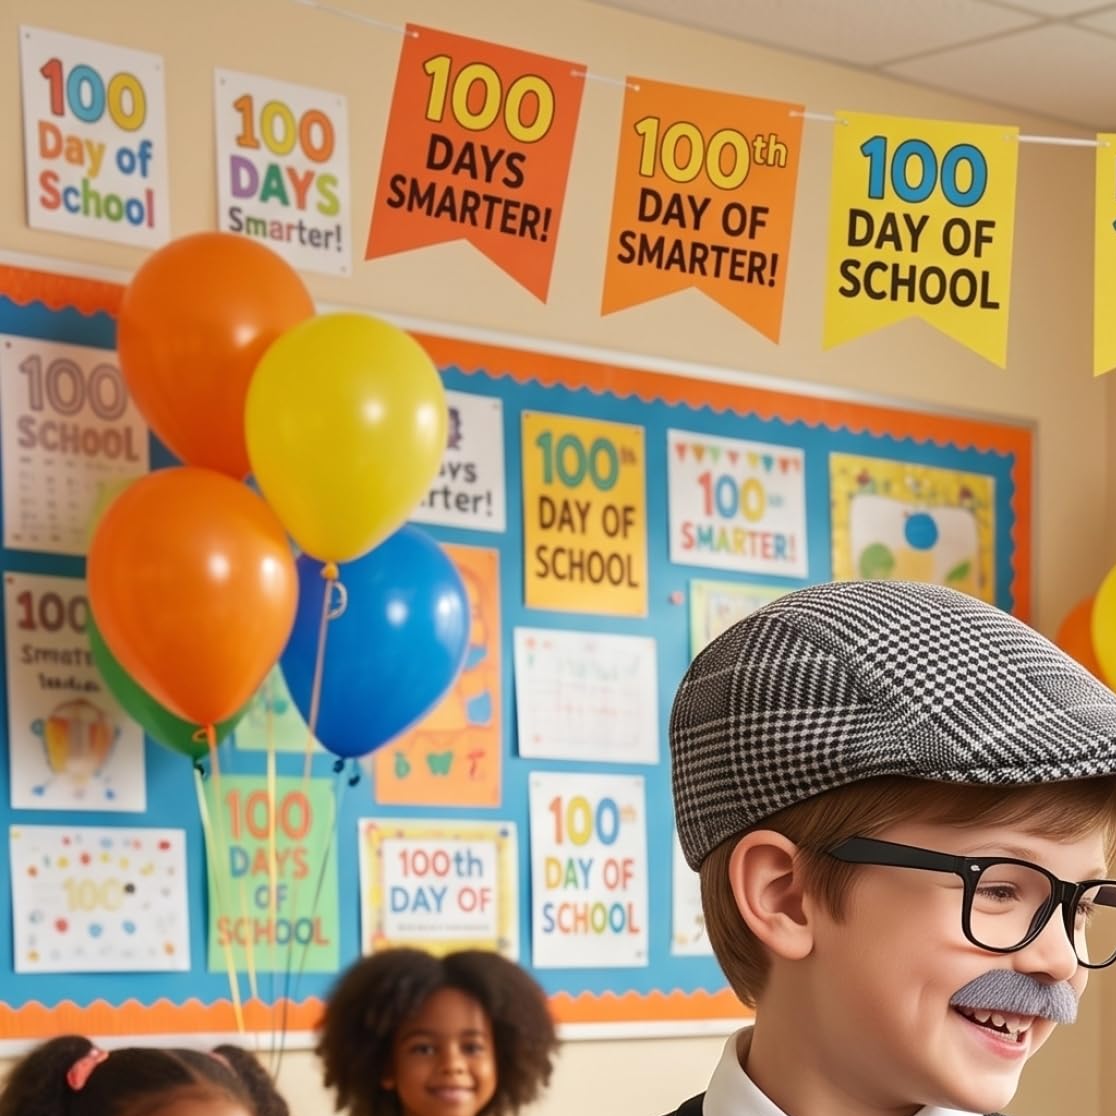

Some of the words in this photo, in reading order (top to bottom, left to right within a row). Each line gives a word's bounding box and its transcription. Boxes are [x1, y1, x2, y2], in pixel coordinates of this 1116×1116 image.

[39, 58, 147, 132] 100
[423, 55, 556, 143] 100
[38, 120, 106, 179] Day
[116, 140, 153, 178] of
[233, 95, 335, 163] 100
[634, 115, 788, 191] 100th
[229, 155, 341, 217] DAYS
[426, 134, 526, 189] DAYS
[860, 135, 988, 208] 100
[38, 170, 155, 229] School
[387, 174, 551, 243] SMARTER!
[638, 188, 712, 230] DAY
[722, 201, 769, 240] OF
[228, 207, 344, 252] Smarter!
[847, 208, 929, 253] DAY
[942, 218, 996, 258] OF
[617, 230, 779, 287] SMARTER!
[839, 259, 1000, 309] SCHOOL
[18, 354, 128, 421] 100
[17, 415, 140, 462] SCHOOL
[539, 495, 591, 533] DAY
[601, 505, 635, 539] OF
[535, 544, 638, 589] SCHOOL
[681, 522, 797, 563] SMARTER!
[224, 790, 312, 840] 100
[229, 846, 309, 879] DAYS
[398, 848, 483, 878] 100th
[544, 857, 594, 891] DAY
[603, 858, 635, 891] OF
[390, 886, 448, 913] DAY
[457, 886, 492, 913] OF
[542, 903, 640, 934] SCHOOL
[217, 916, 328, 946] SCHOOL
